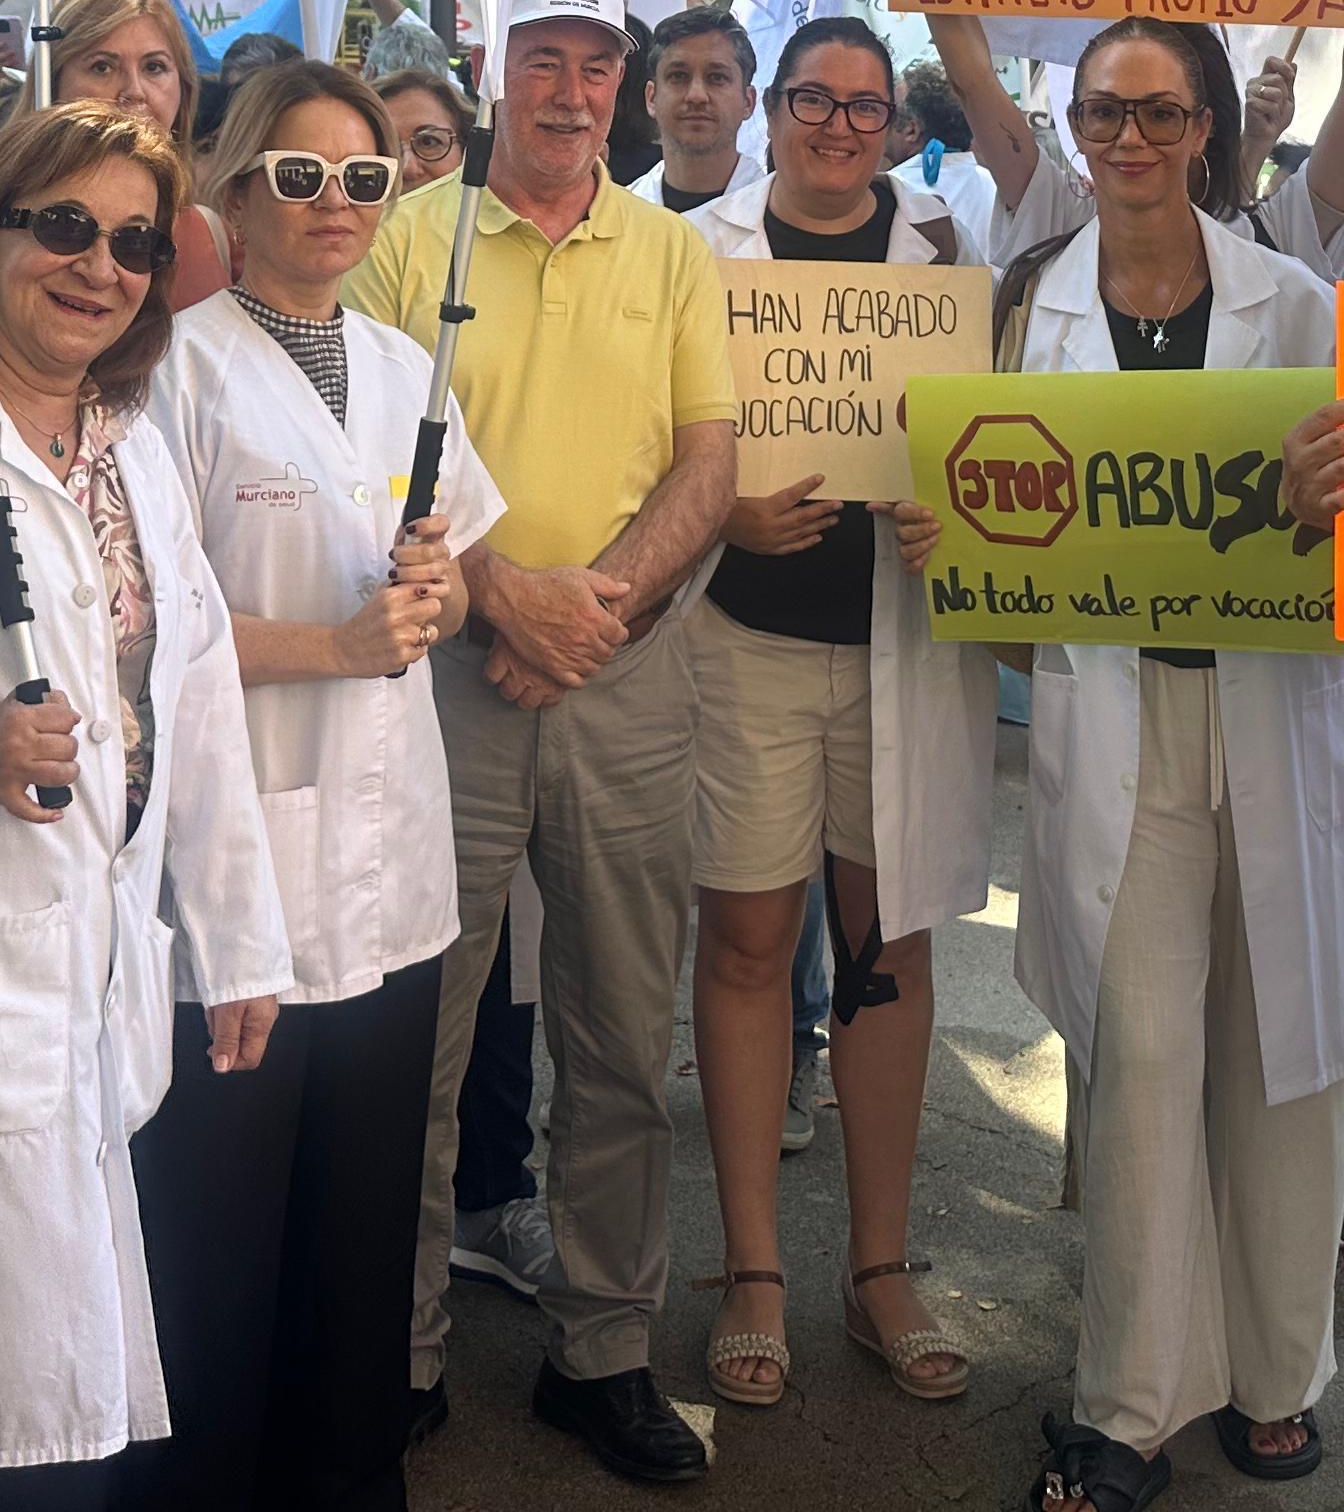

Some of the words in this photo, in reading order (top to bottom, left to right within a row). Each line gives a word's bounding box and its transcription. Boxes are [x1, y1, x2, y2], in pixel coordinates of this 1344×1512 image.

[726, 289, 801, 336] HAN
[822, 287, 957, 339] ACABADO
[764, 347, 827, 384] CON
[236, 488, 296, 502] Murciano
[958, 458, 1067, 514] STOP
[931, 566, 977, 616] No
[980, 572, 1055, 617] todo
[1069, 573, 1140, 619] vale
[1150, 592, 1204, 632] por
